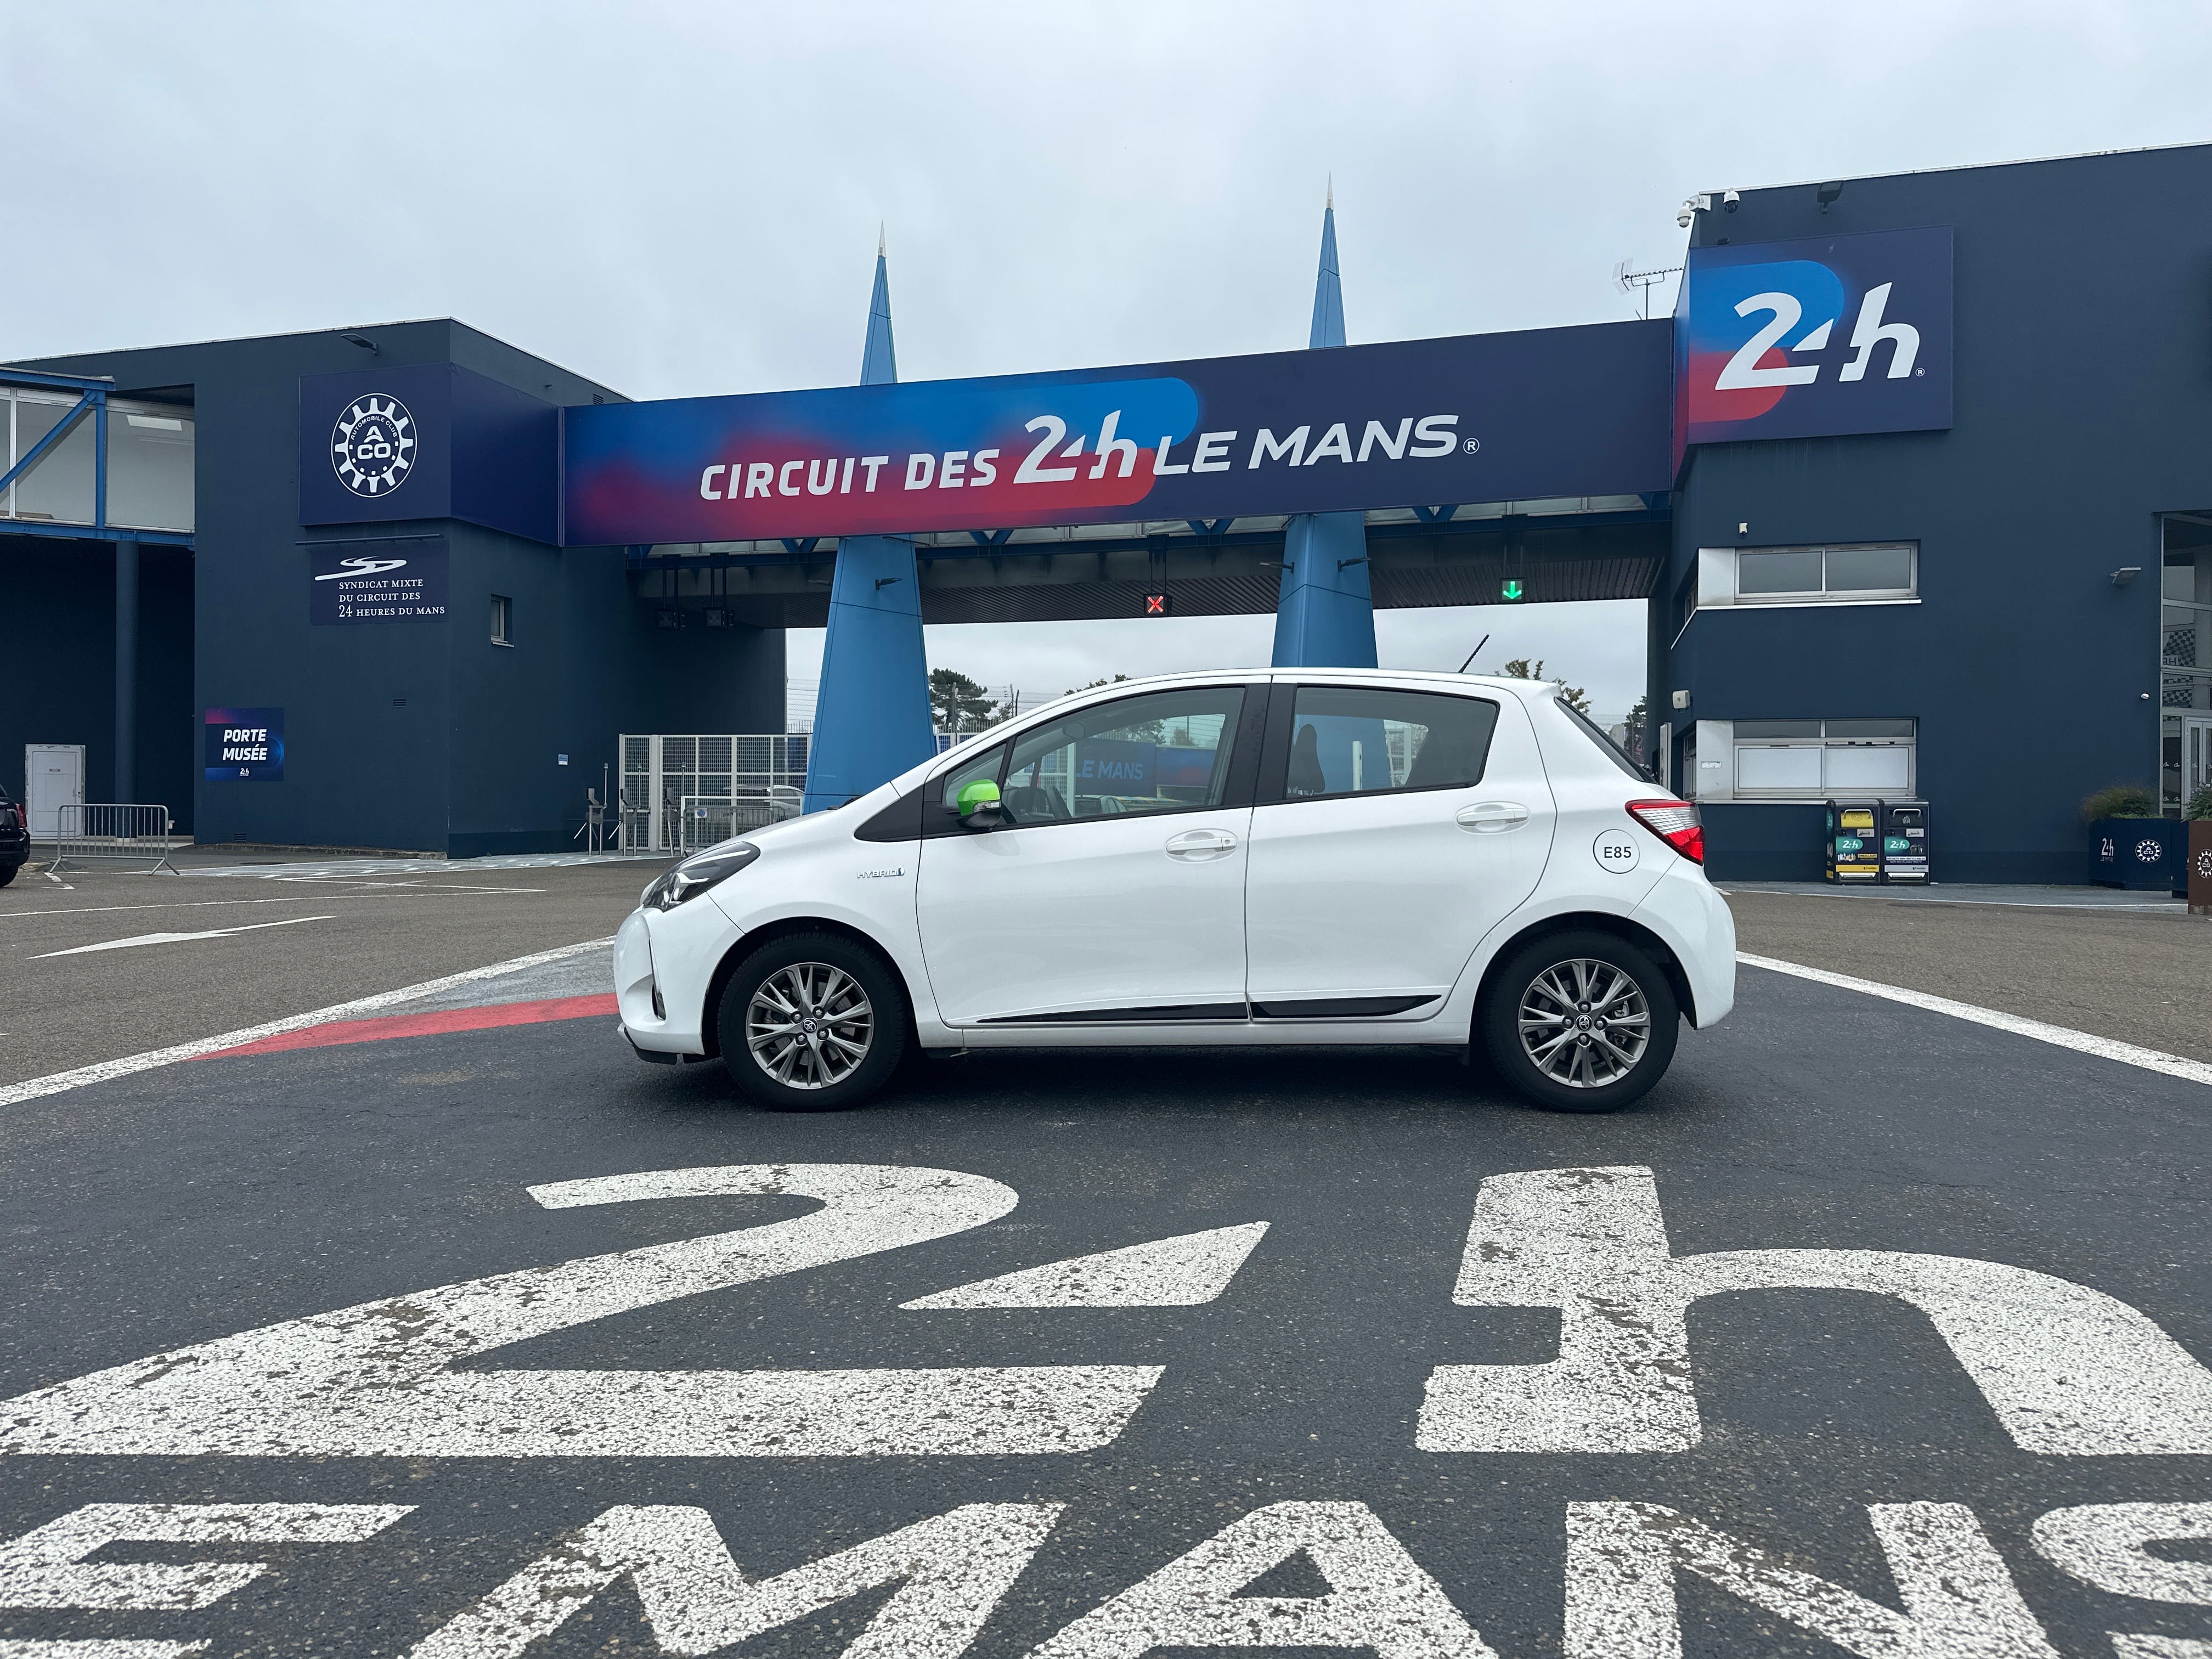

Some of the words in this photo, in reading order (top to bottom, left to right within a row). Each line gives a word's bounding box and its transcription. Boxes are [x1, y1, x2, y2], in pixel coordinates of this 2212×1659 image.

[350, 415, 385, 441] AUTOMOBILE
[385, 420, 398, 438] CLUB
[700, 455, 889, 500] CIRCUIT
[904, 449, 1000, 490] DES
[1153, 431, 1238, 475] LE
[1248, 414, 1459, 470] MANS
[339, 580, 388, 590] SYNDICAT
[391, 579, 424, 588] MIXTE
[339, 594, 353, 602] DU
[357, 593, 399, 602] CIRCUIT
[402, 592, 420, 600] DES
[338, 605, 353, 617] 24
[357, 608, 395, 617] HEURES
[416, 606, 445, 614] MANS
[223, 729, 267, 742] PORTE
[222, 743, 268, 760] MUSÉE
[1098, 760, 1143, 780] MANS
[1604, 846, 1632, 859] E85
[857, 870, 898, 879] HYBRID
